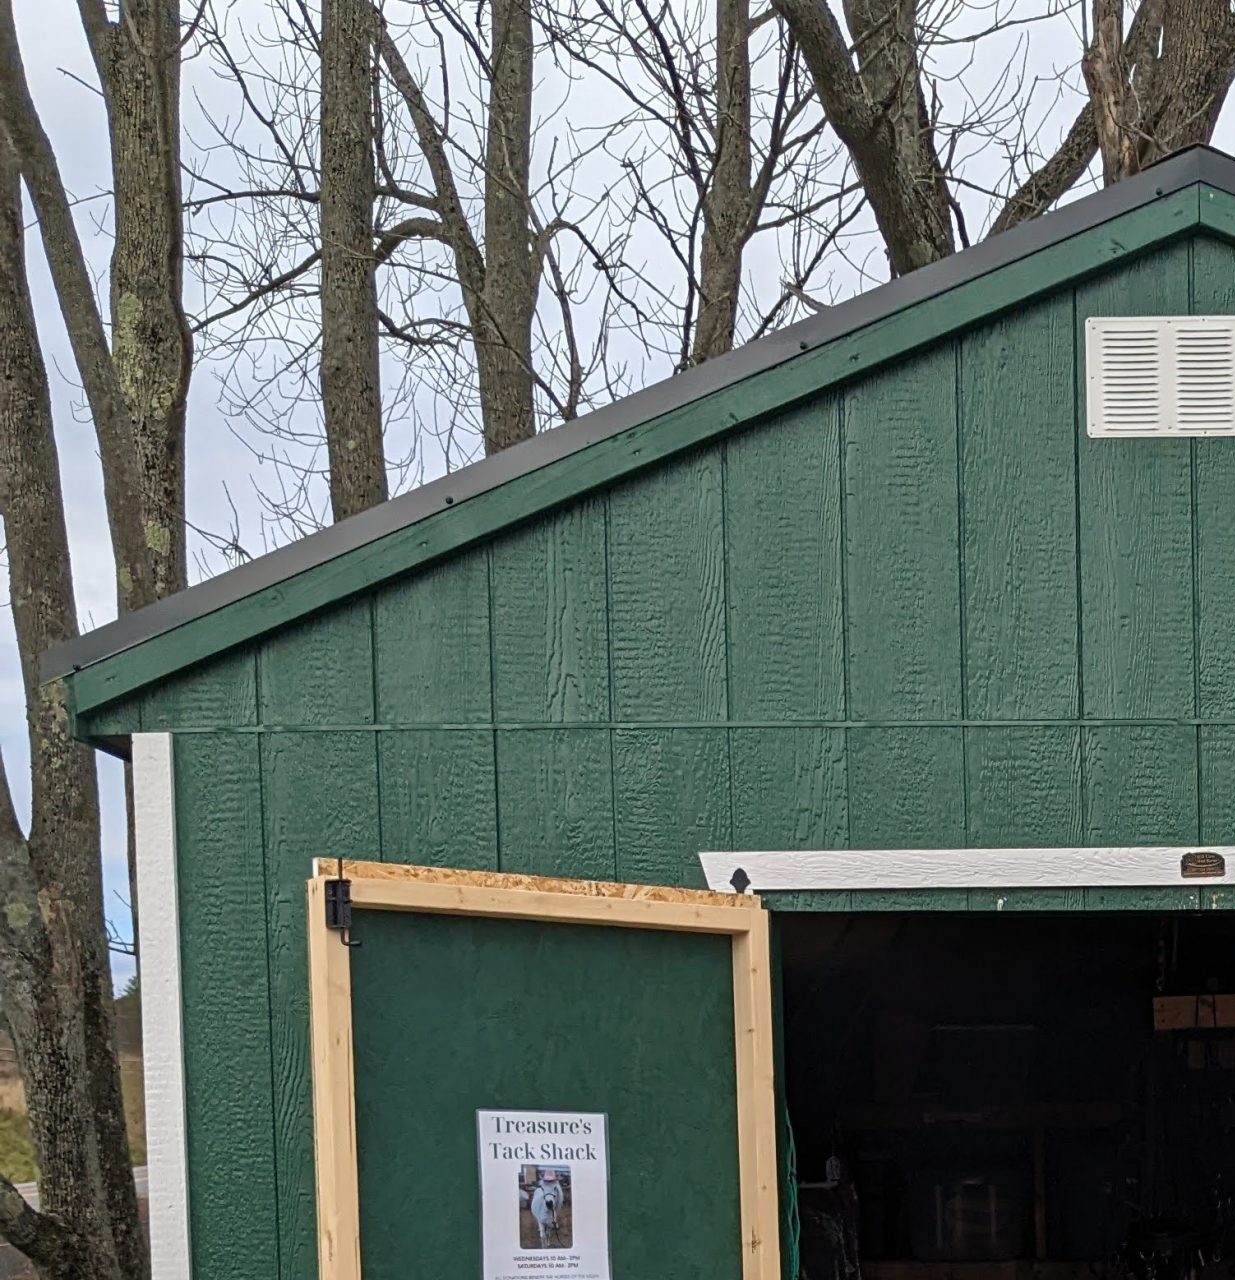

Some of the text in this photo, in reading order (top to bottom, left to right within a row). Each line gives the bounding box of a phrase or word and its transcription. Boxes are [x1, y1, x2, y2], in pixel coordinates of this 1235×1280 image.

[491, 1116, 592, 1135] Treasure's
[489, 1142, 597, 1160] Tack Shack
